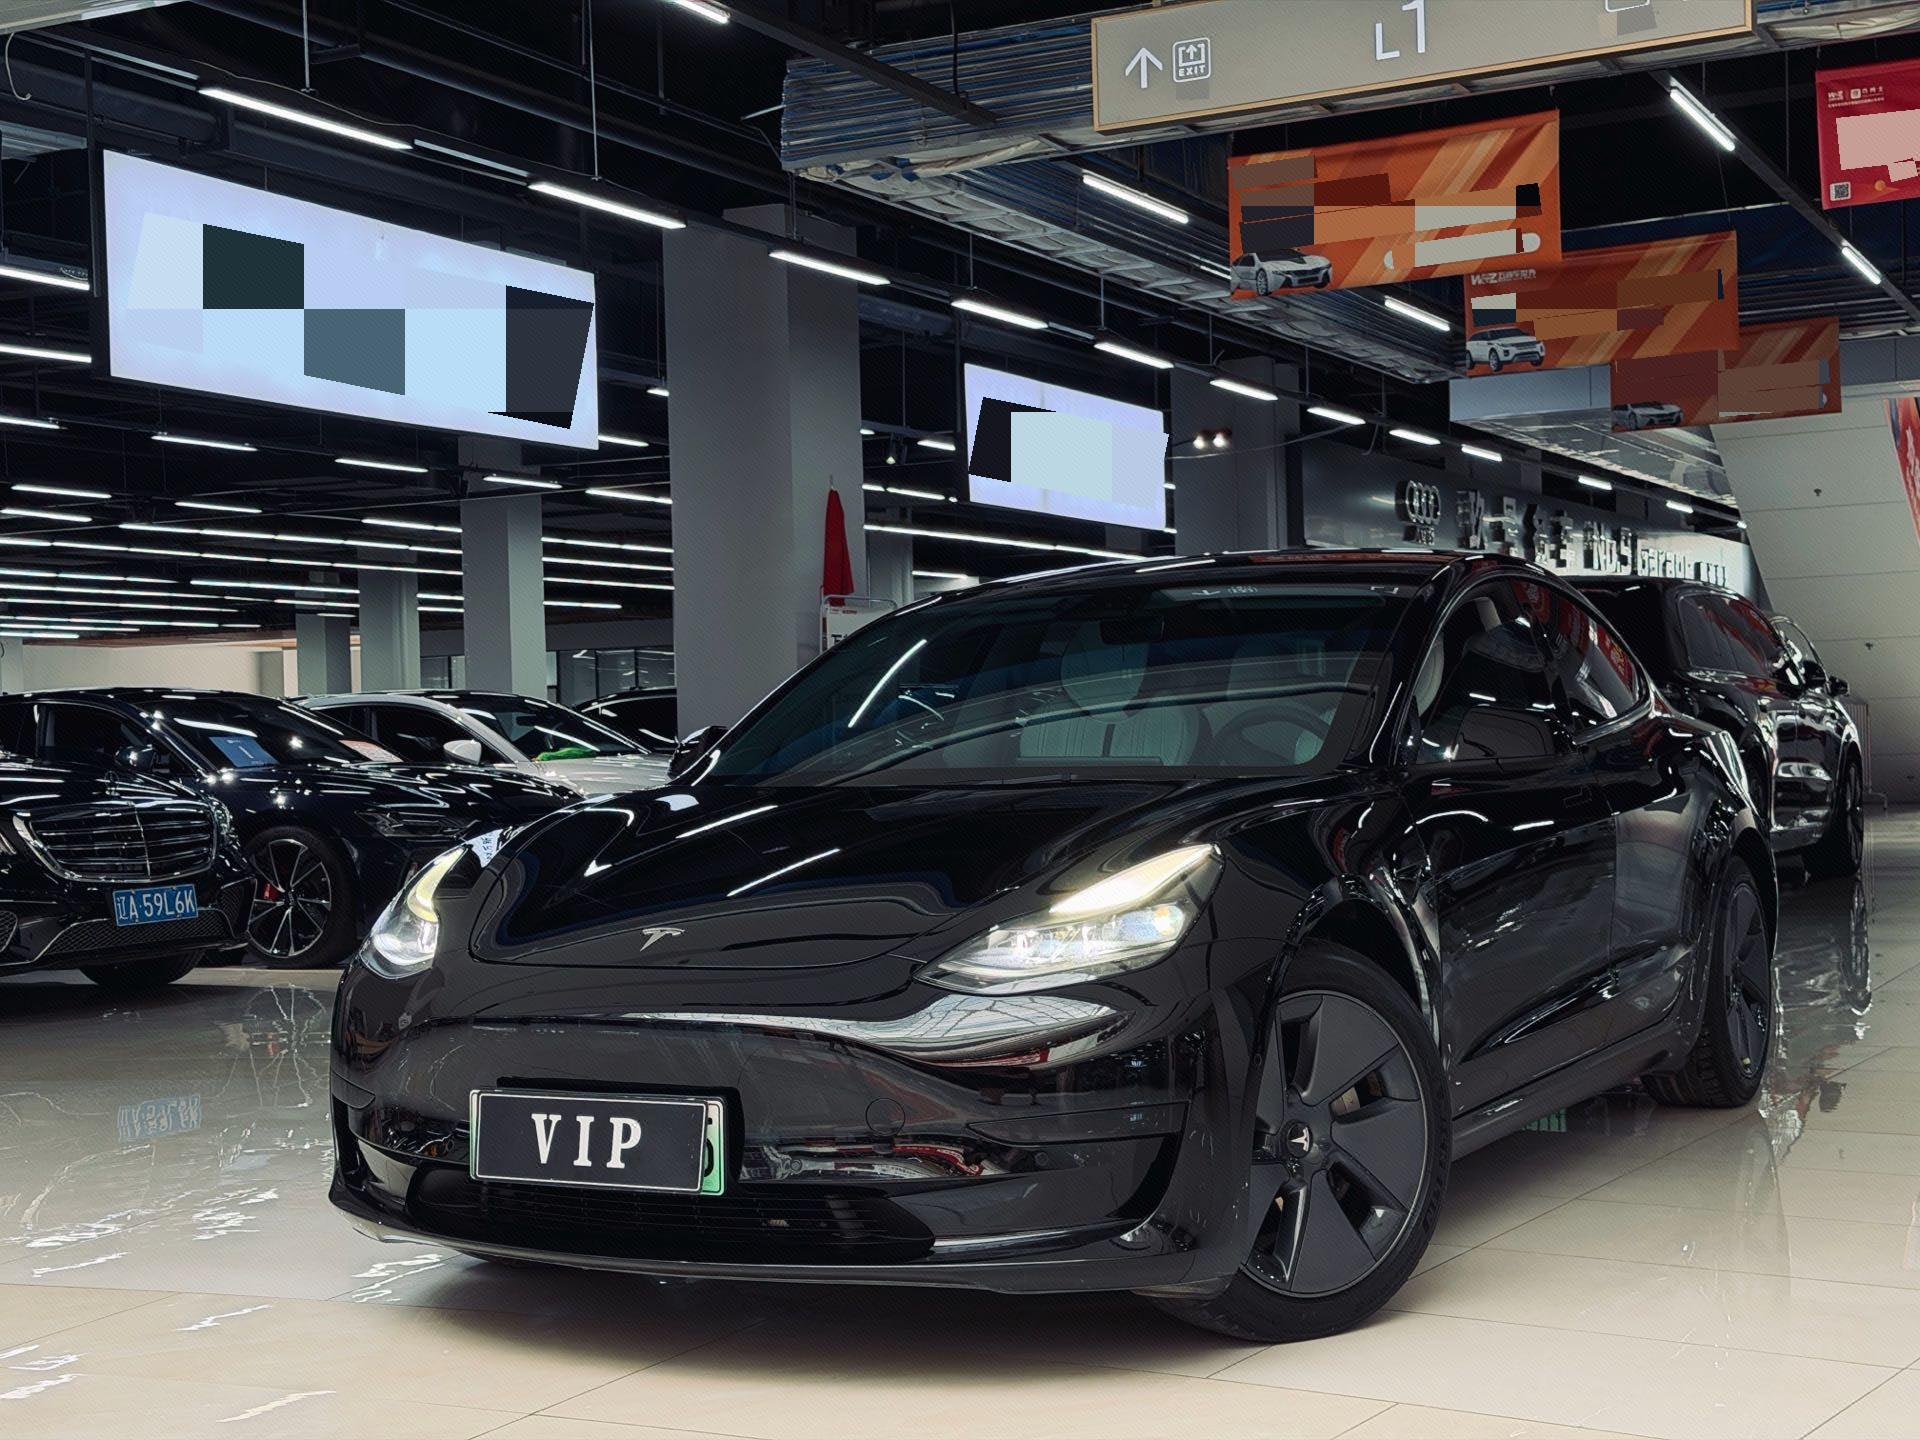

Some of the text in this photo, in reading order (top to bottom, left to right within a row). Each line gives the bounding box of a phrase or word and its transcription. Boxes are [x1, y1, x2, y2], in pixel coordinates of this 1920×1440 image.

[1375, 0, 1426, 61] L1
[1178, 64, 1206, 77] EXIT
[531, 1113, 642, 1169] VIP
